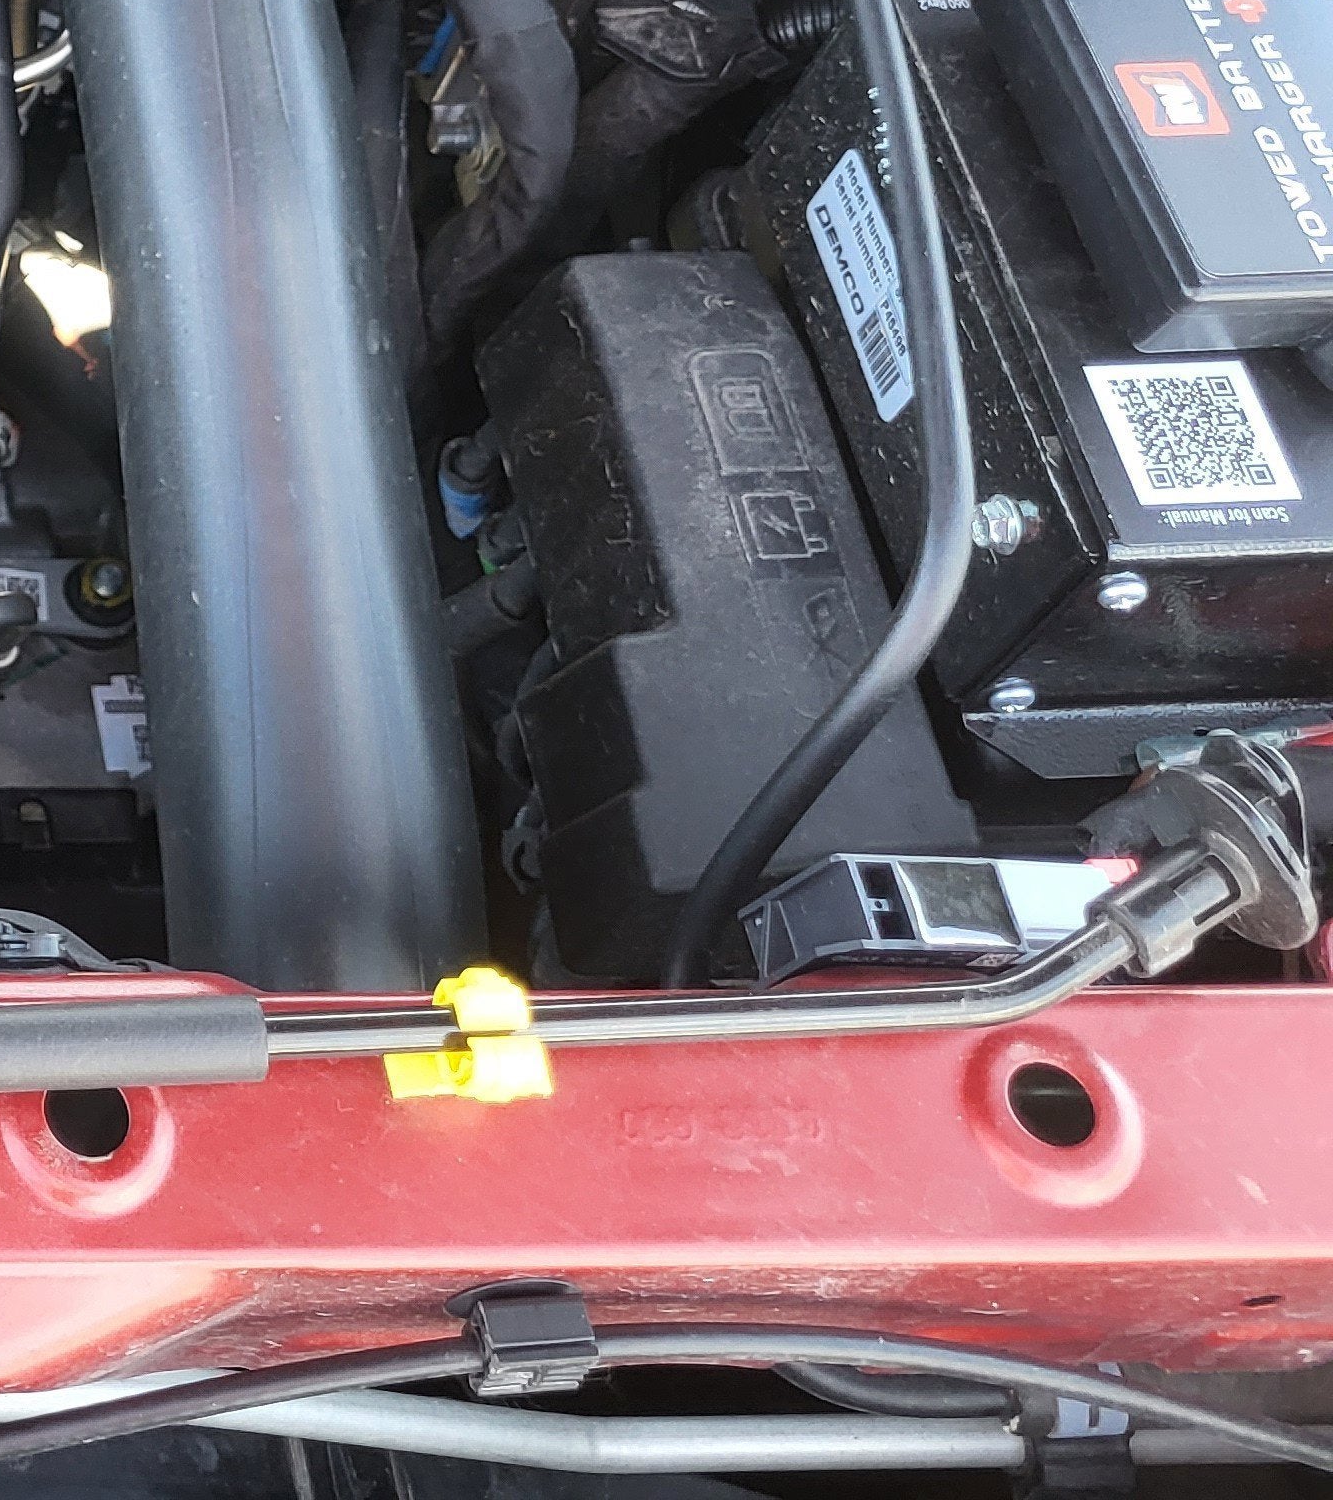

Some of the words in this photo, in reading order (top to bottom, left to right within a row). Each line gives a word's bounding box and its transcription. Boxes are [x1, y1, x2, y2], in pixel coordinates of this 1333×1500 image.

[834, 173, 857, 222] Serial
[844, 159, 868, 211] Model
[1253, 125, 1333, 264] TOWED
[813, 203, 865, 316] DEMCO
[1159, 507, 1228, 529] Manual:
[1228, 507, 1252, 526] for
[1251, 506, 1291, 525] Scan
